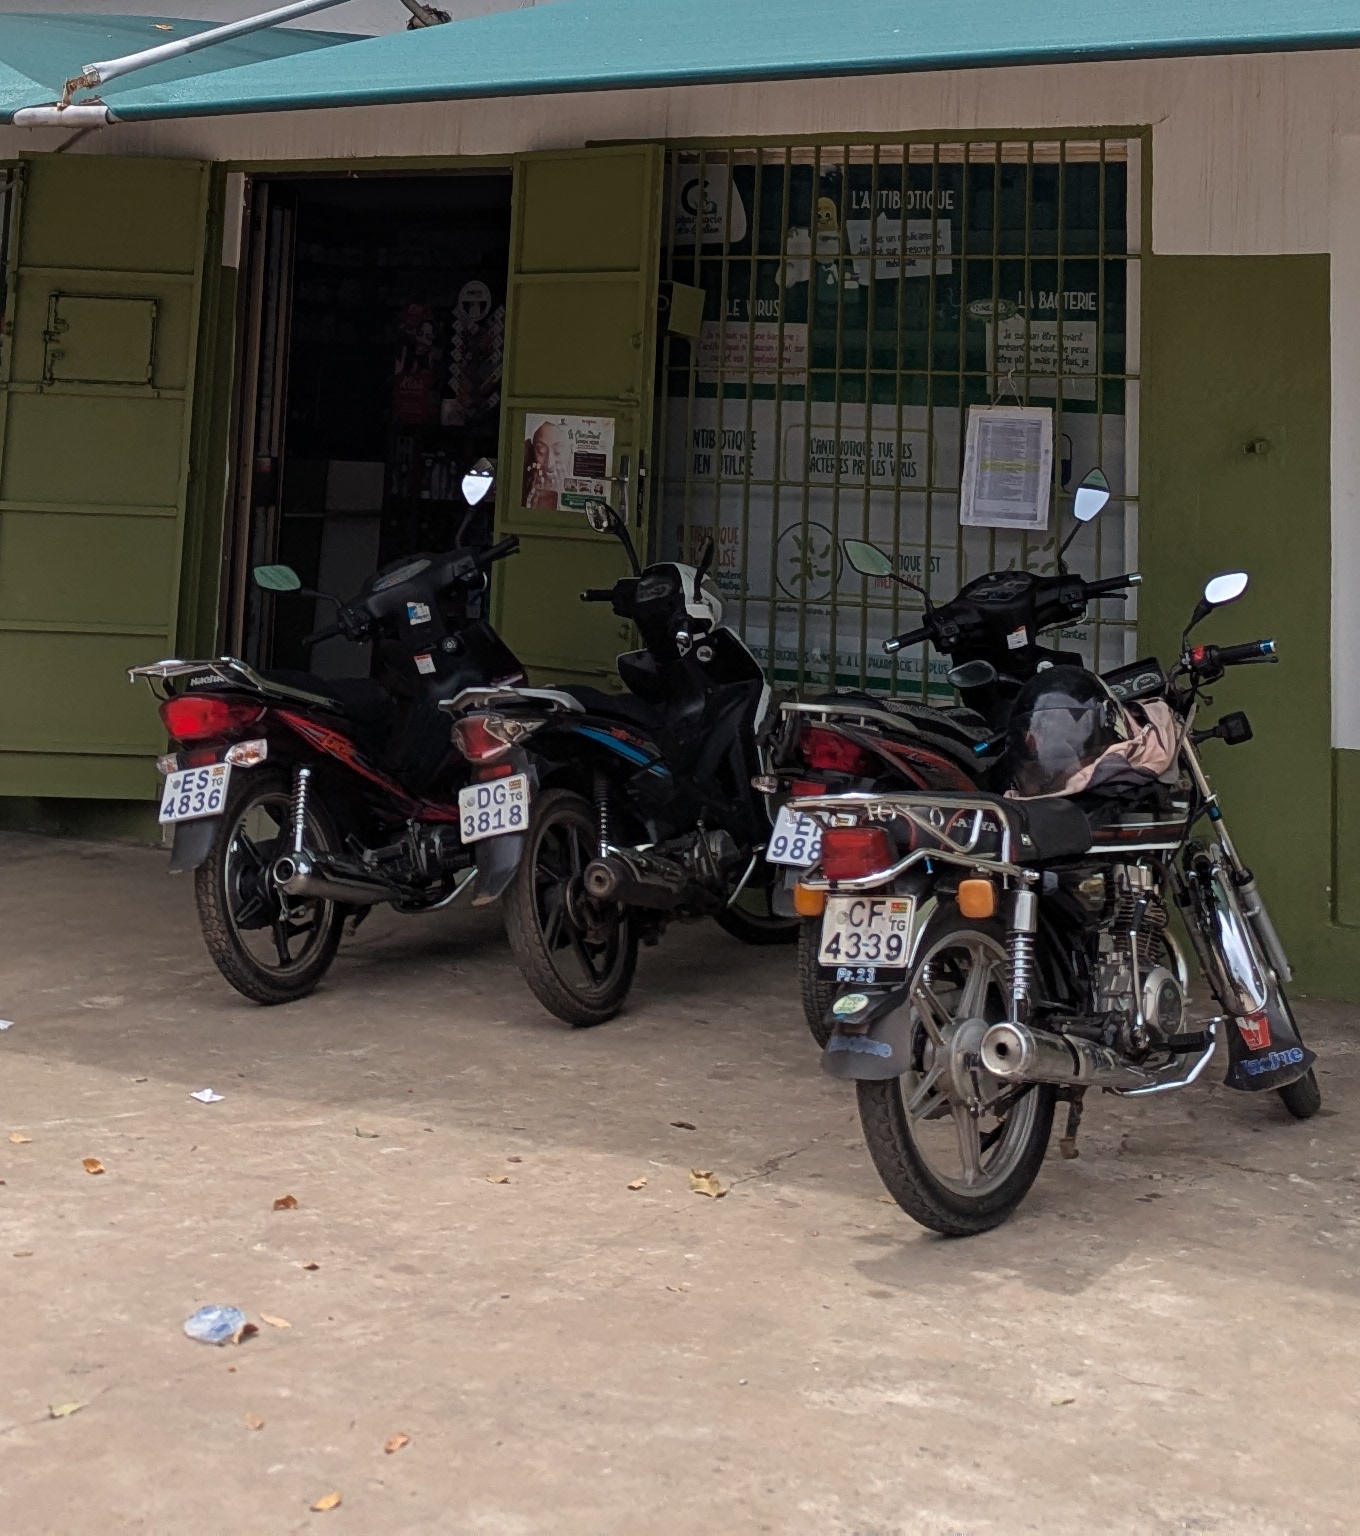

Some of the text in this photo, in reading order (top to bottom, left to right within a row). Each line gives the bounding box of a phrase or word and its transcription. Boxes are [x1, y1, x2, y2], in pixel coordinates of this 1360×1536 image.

[852, 190, 955, 210] L'ATIBOTIQUE
[675, 214, 723, 225] pharacie
[688, 429, 757, 451] NTIBOTIQE
[810, 437, 913, 460] L'ANTIIOTIQUE TUE ES
[890, 460, 917, 478] VRUS
[868, 657, 913, 673] PHARMCIE
[181, 769, 223, 794] ES TG
[163, 788, 221, 818] 4836
[477, 784, 523, 809] DG TG
[463, 804, 522, 837] 3818
[772, 835, 822, 862] 988
[849, 900, 906, 932] CF TG
[825, 931, 902, 961] 4339
